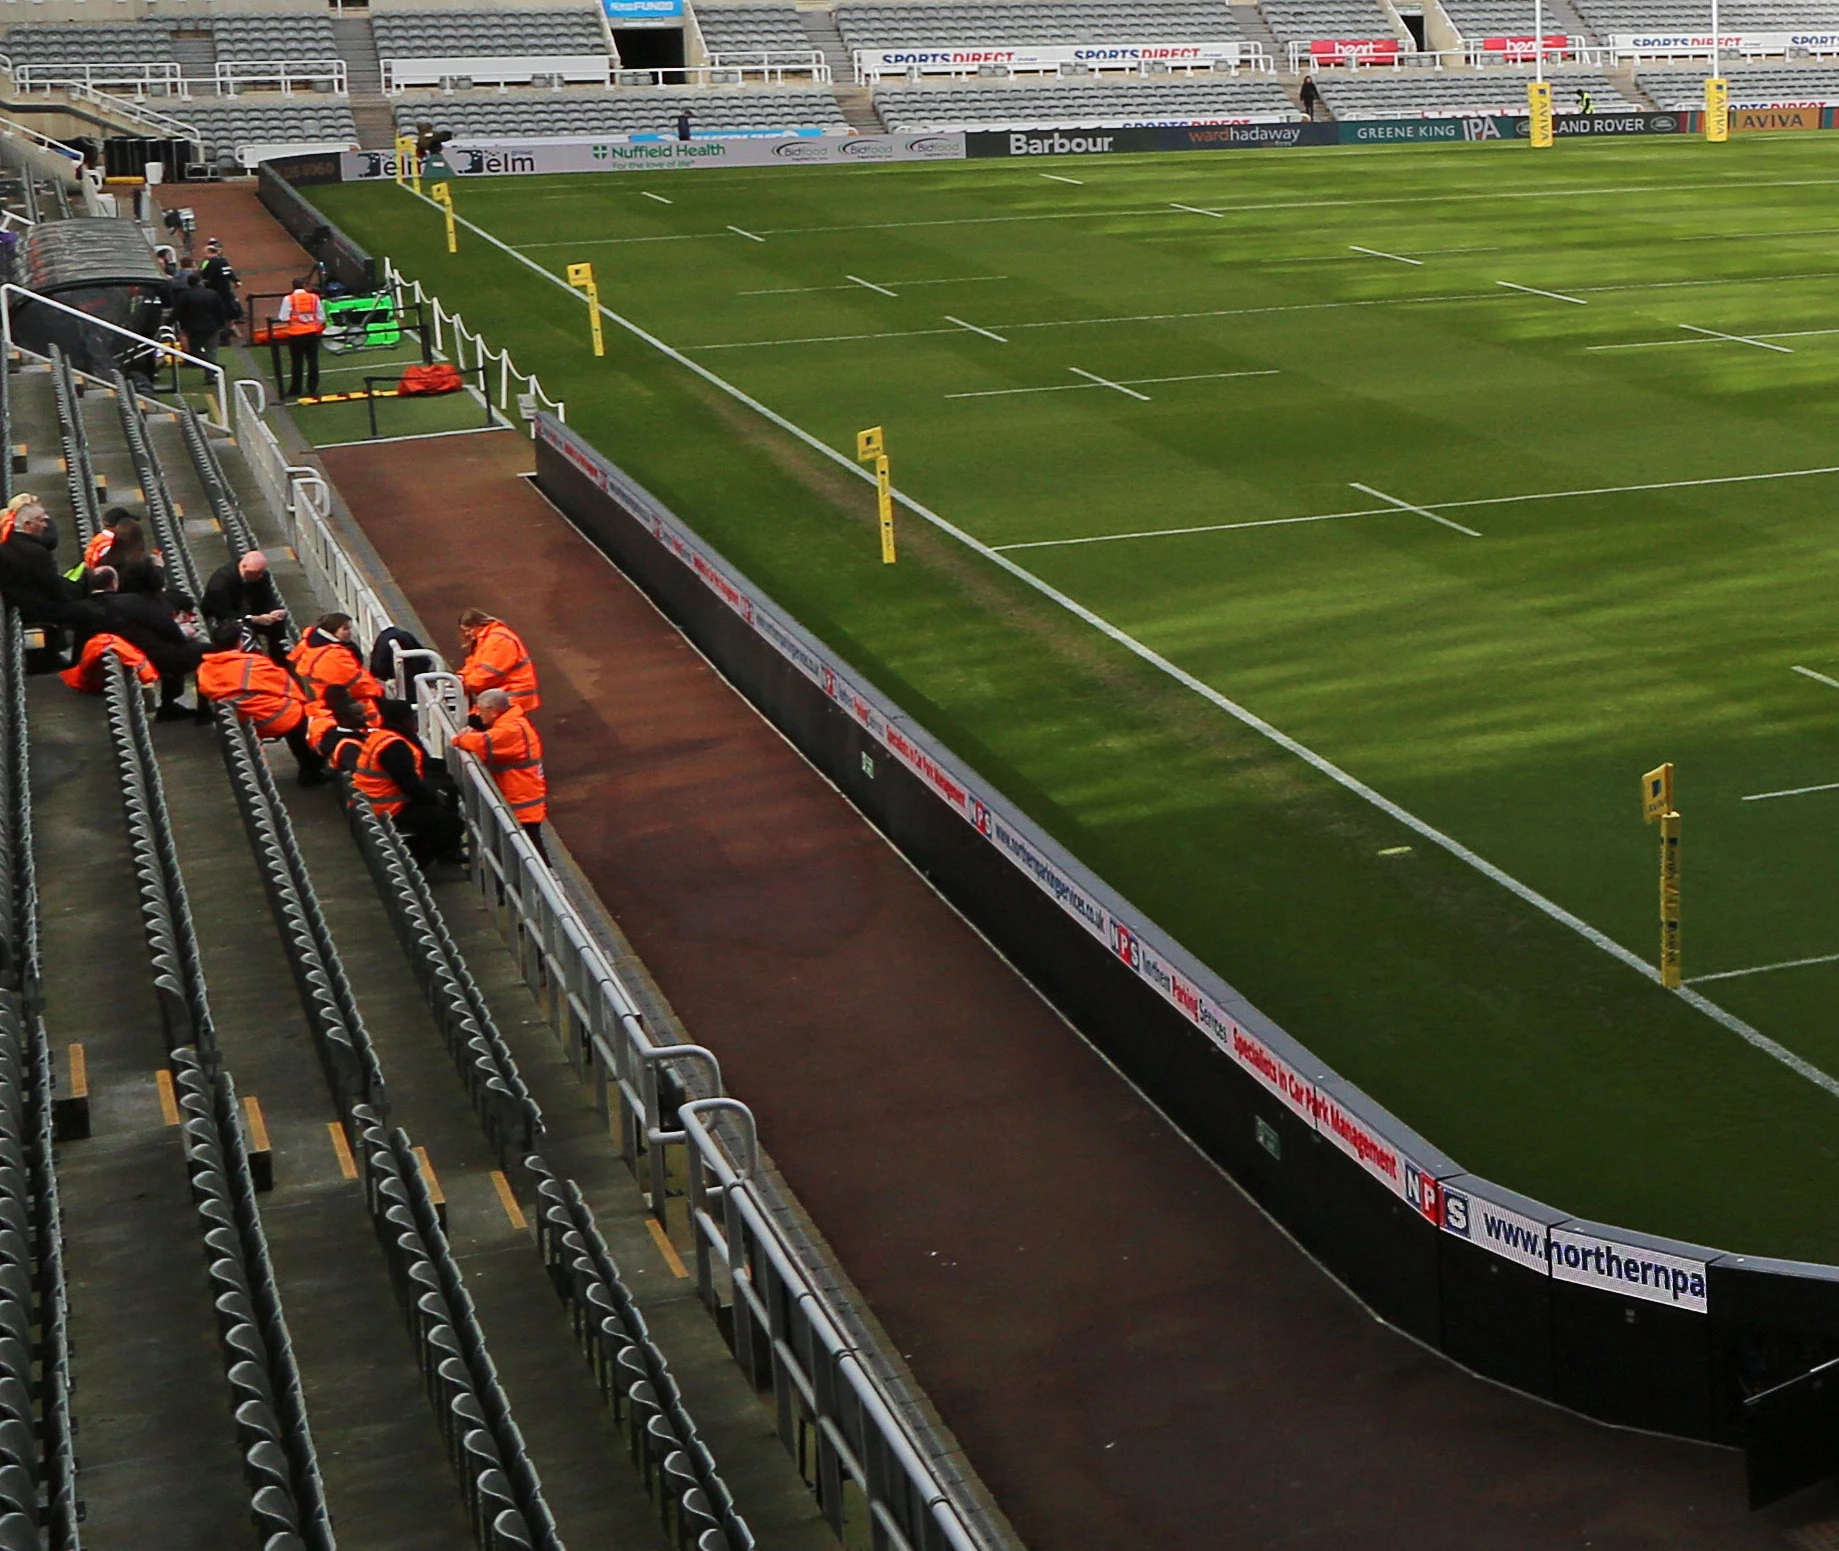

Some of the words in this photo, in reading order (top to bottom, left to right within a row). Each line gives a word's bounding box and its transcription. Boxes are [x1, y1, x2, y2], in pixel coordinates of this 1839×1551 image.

[1358, 127, 1416, 141] GREENE
[1419, 125, 1455, 139] KING
[1462, 117, 1501, 141] IPA
[1593, 118, 1645, 133] ROVER
[1744, 112, 1804, 128] AVIVA
[1009, 133, 1113, 155] Barbour
[1189, 127, 1301, 144] wardhadaway
[612, 145, 673, 160] Nuffield
[677, 143, 726, 157] Health
[1110, 920, 1141, 971] NPS
[1405, 1167, 1468, 1233] NPS
